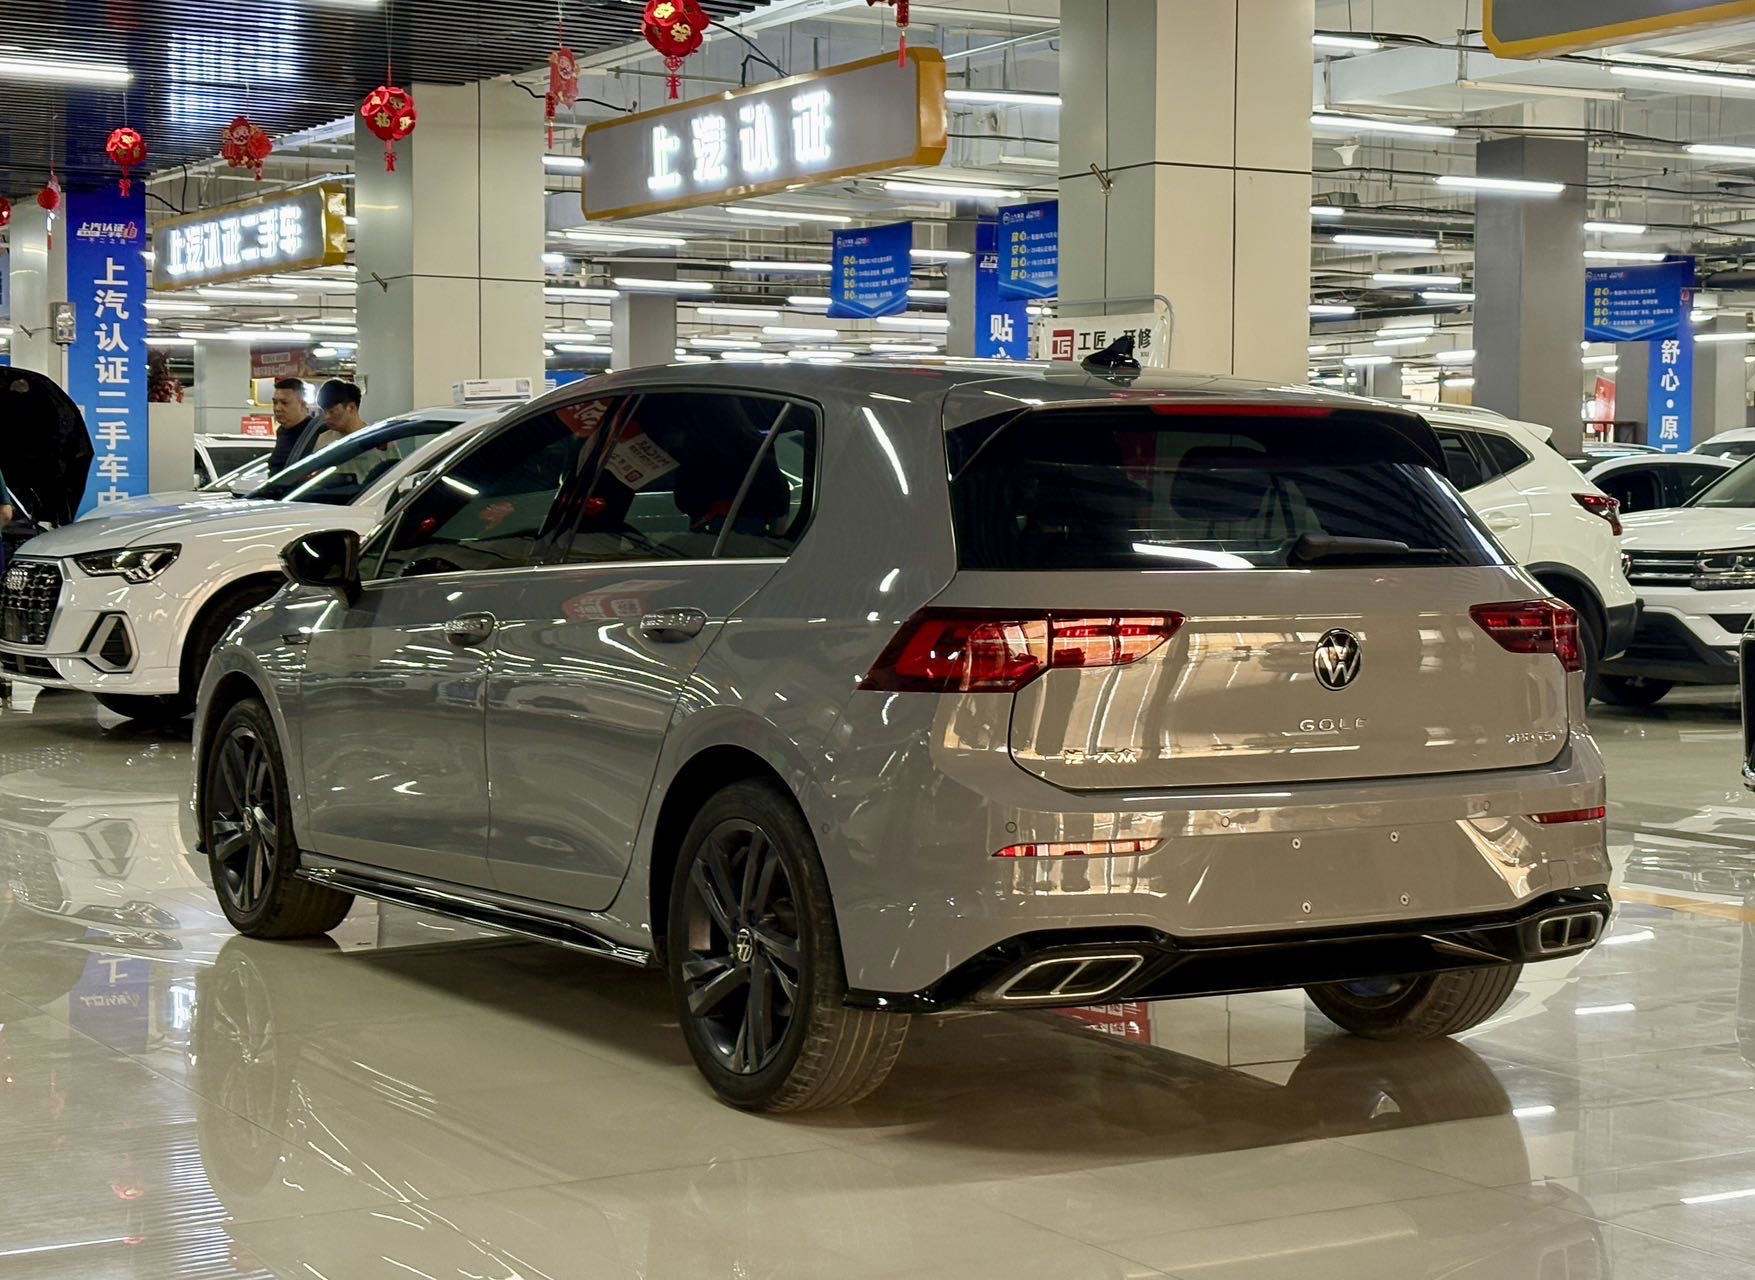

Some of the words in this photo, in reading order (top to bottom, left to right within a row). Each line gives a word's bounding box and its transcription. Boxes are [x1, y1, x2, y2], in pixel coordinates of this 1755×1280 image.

[648, 89, 831, 190] 上汽认证
[167, 205, 302, 276] 上汽认证二手车
[1299, 718, 1367, 732] GOLF
